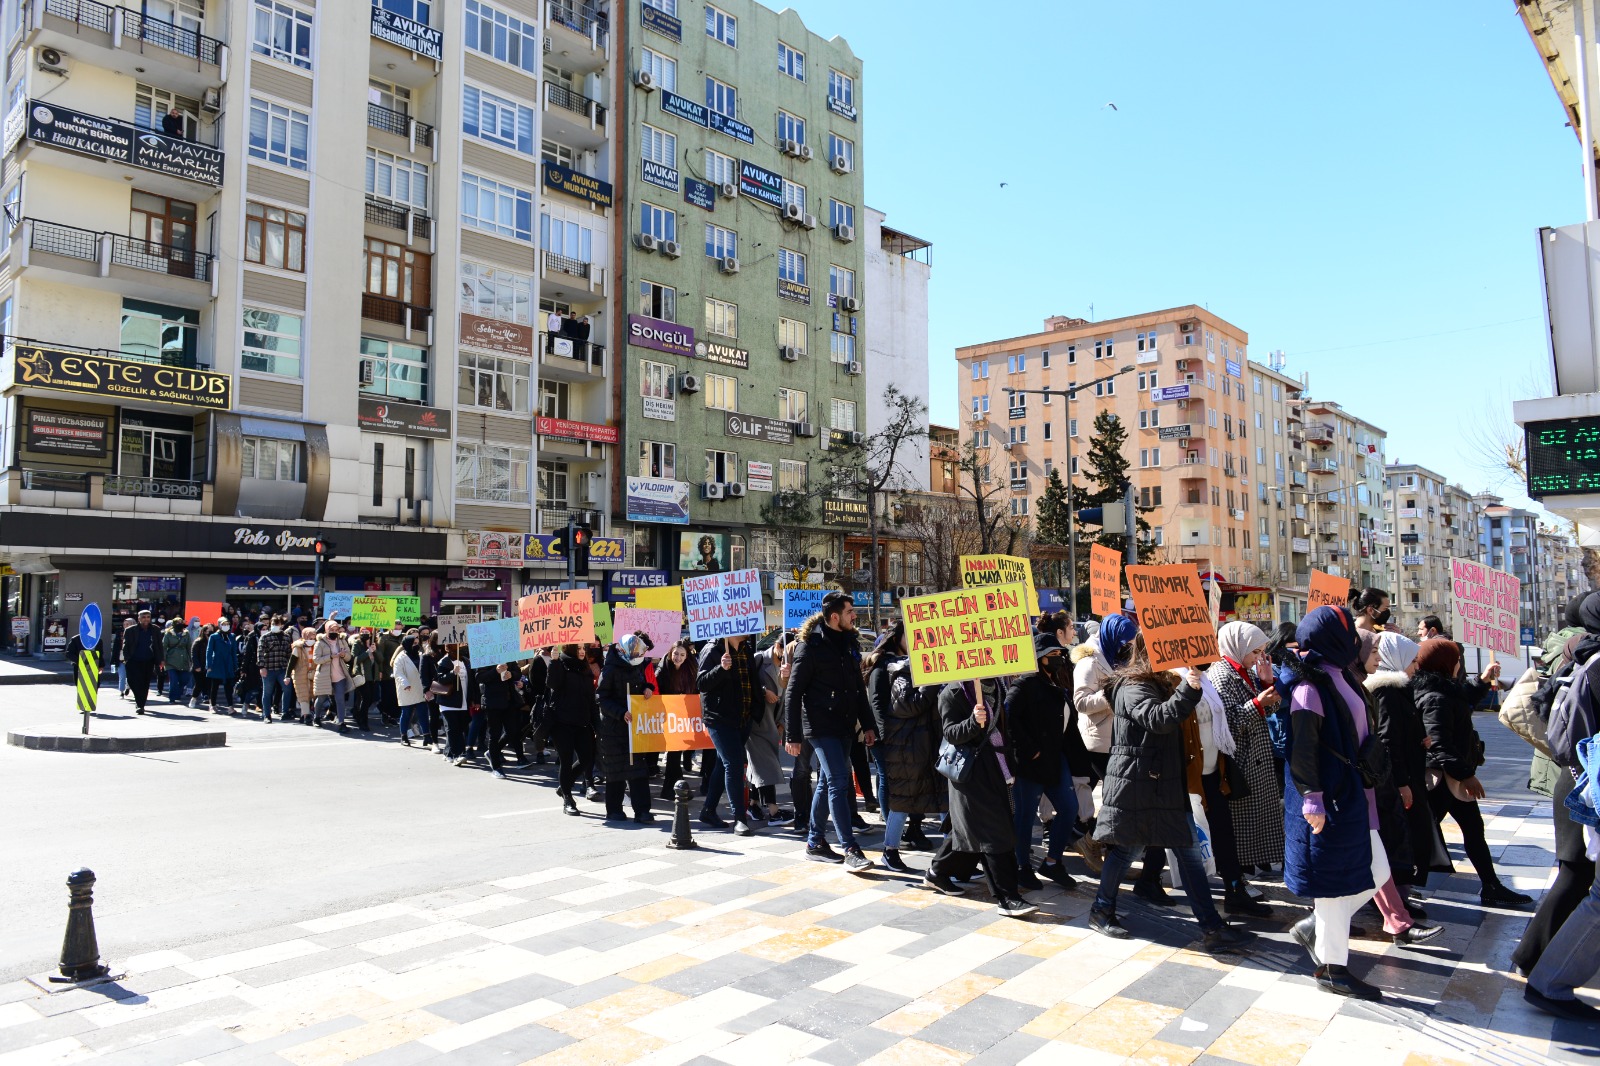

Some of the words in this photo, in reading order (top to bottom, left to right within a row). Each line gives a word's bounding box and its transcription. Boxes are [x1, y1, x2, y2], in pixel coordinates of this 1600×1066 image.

[393, 17, 440, 43] AVUKAT
[372, 21, 417, 49] Hüsameddin
[418, 38, 440, 59] UYSAL
[669, 95, 702, 117] AVUKAT
[54, 120, 88, 135] HUKUK
[90, 129, 129, 145] BÜROSU
[727, 119, 751, 135] AVUKAT
[52, 132, 76, 146] Halil
[171, 143, 220, 163] MAVLU
[162, 164, 181, 173] Emre
[645, 162, 677, 182] AVUKAT
[743, 165, 781, 188] AVUKAT
[564, 181, 588, 197] MURAT
[572, 174, 599, 190] AVUKAT
[742, 181, 758, 195] Murat
[787, 282, 810, 295] AVUKAT
[631, 323, 692, 347] SONGÜL
[708, 344, 748, 360] AVUKAT
[60, 357, 142, 386] ESTE
[154, 369, 226, 394] CLUB
[107, 384, 148, 395] GÜZELLİK
[159, 391, 194, 401] SAĞLIKLI
[196, 395, 224, 404] YAŞAM
[656, 402, 674, 410] HEKİMİ
[32, 414, 56, 424] PINAR
[57, 416, 104, 429] YÜZBAŞIOĞLU
[556, 421, 580, 430] YENİDEN
[580, 424, 598, 432] REFAH
[598, 427, 617, 435] PARTİSİ
[56, 427, 74, 436] YÜKSEK
[162, 483, 198, 496] SPOR
[640, 482, 674, 493] YILDIRIM
[845, 503, 868, 513] HUKUK
[233, 527, 270, 546] Foto
[275, 530, 316, 551] Spor
[463, 568, 496, 579] LORIS
[965, 558, 997, 571] İNSAN
[621, 574, 668, 586] TELASEL
[685, 575, 720, 593] YAŞAMA
[723, 570, 758, 587] YILLAR
[965, 570, 1002, 585] OLMAYA
[1133, 573, 1194, 597] OTURMAK
[722, 584, 751, 602] ŞİMDİ
[520, 602, 564, 623] YAŞLANMAK
[569, 601, 589, 616] İÇİN
[689, 604, 724, 623] YILLARA
[726, 600, 762, 616] YAŞAM
[907, 602, 939, 623] HER
[941, 592, 979, 618] GÜN
[985, 588, 1019, 612] BİN
[523, 617, 551, 635] AKTİF
[558, 616, 583, 629] YAŞ
[1141, 604, 1211, 630] GÜNÜMÜZÜN
[524, 630, 584, 649] ALMALIYIZ.
[913, 624, 957, 651] ADIM
[959, 613, 1031, 645] SAĞLIKLI
[921, 650, 949, 674] BİR
[956, 646, 997, 670] ASIR
[1002, 643, 1019, 664] !!!
[635, 712, 665, 735] Aktif
